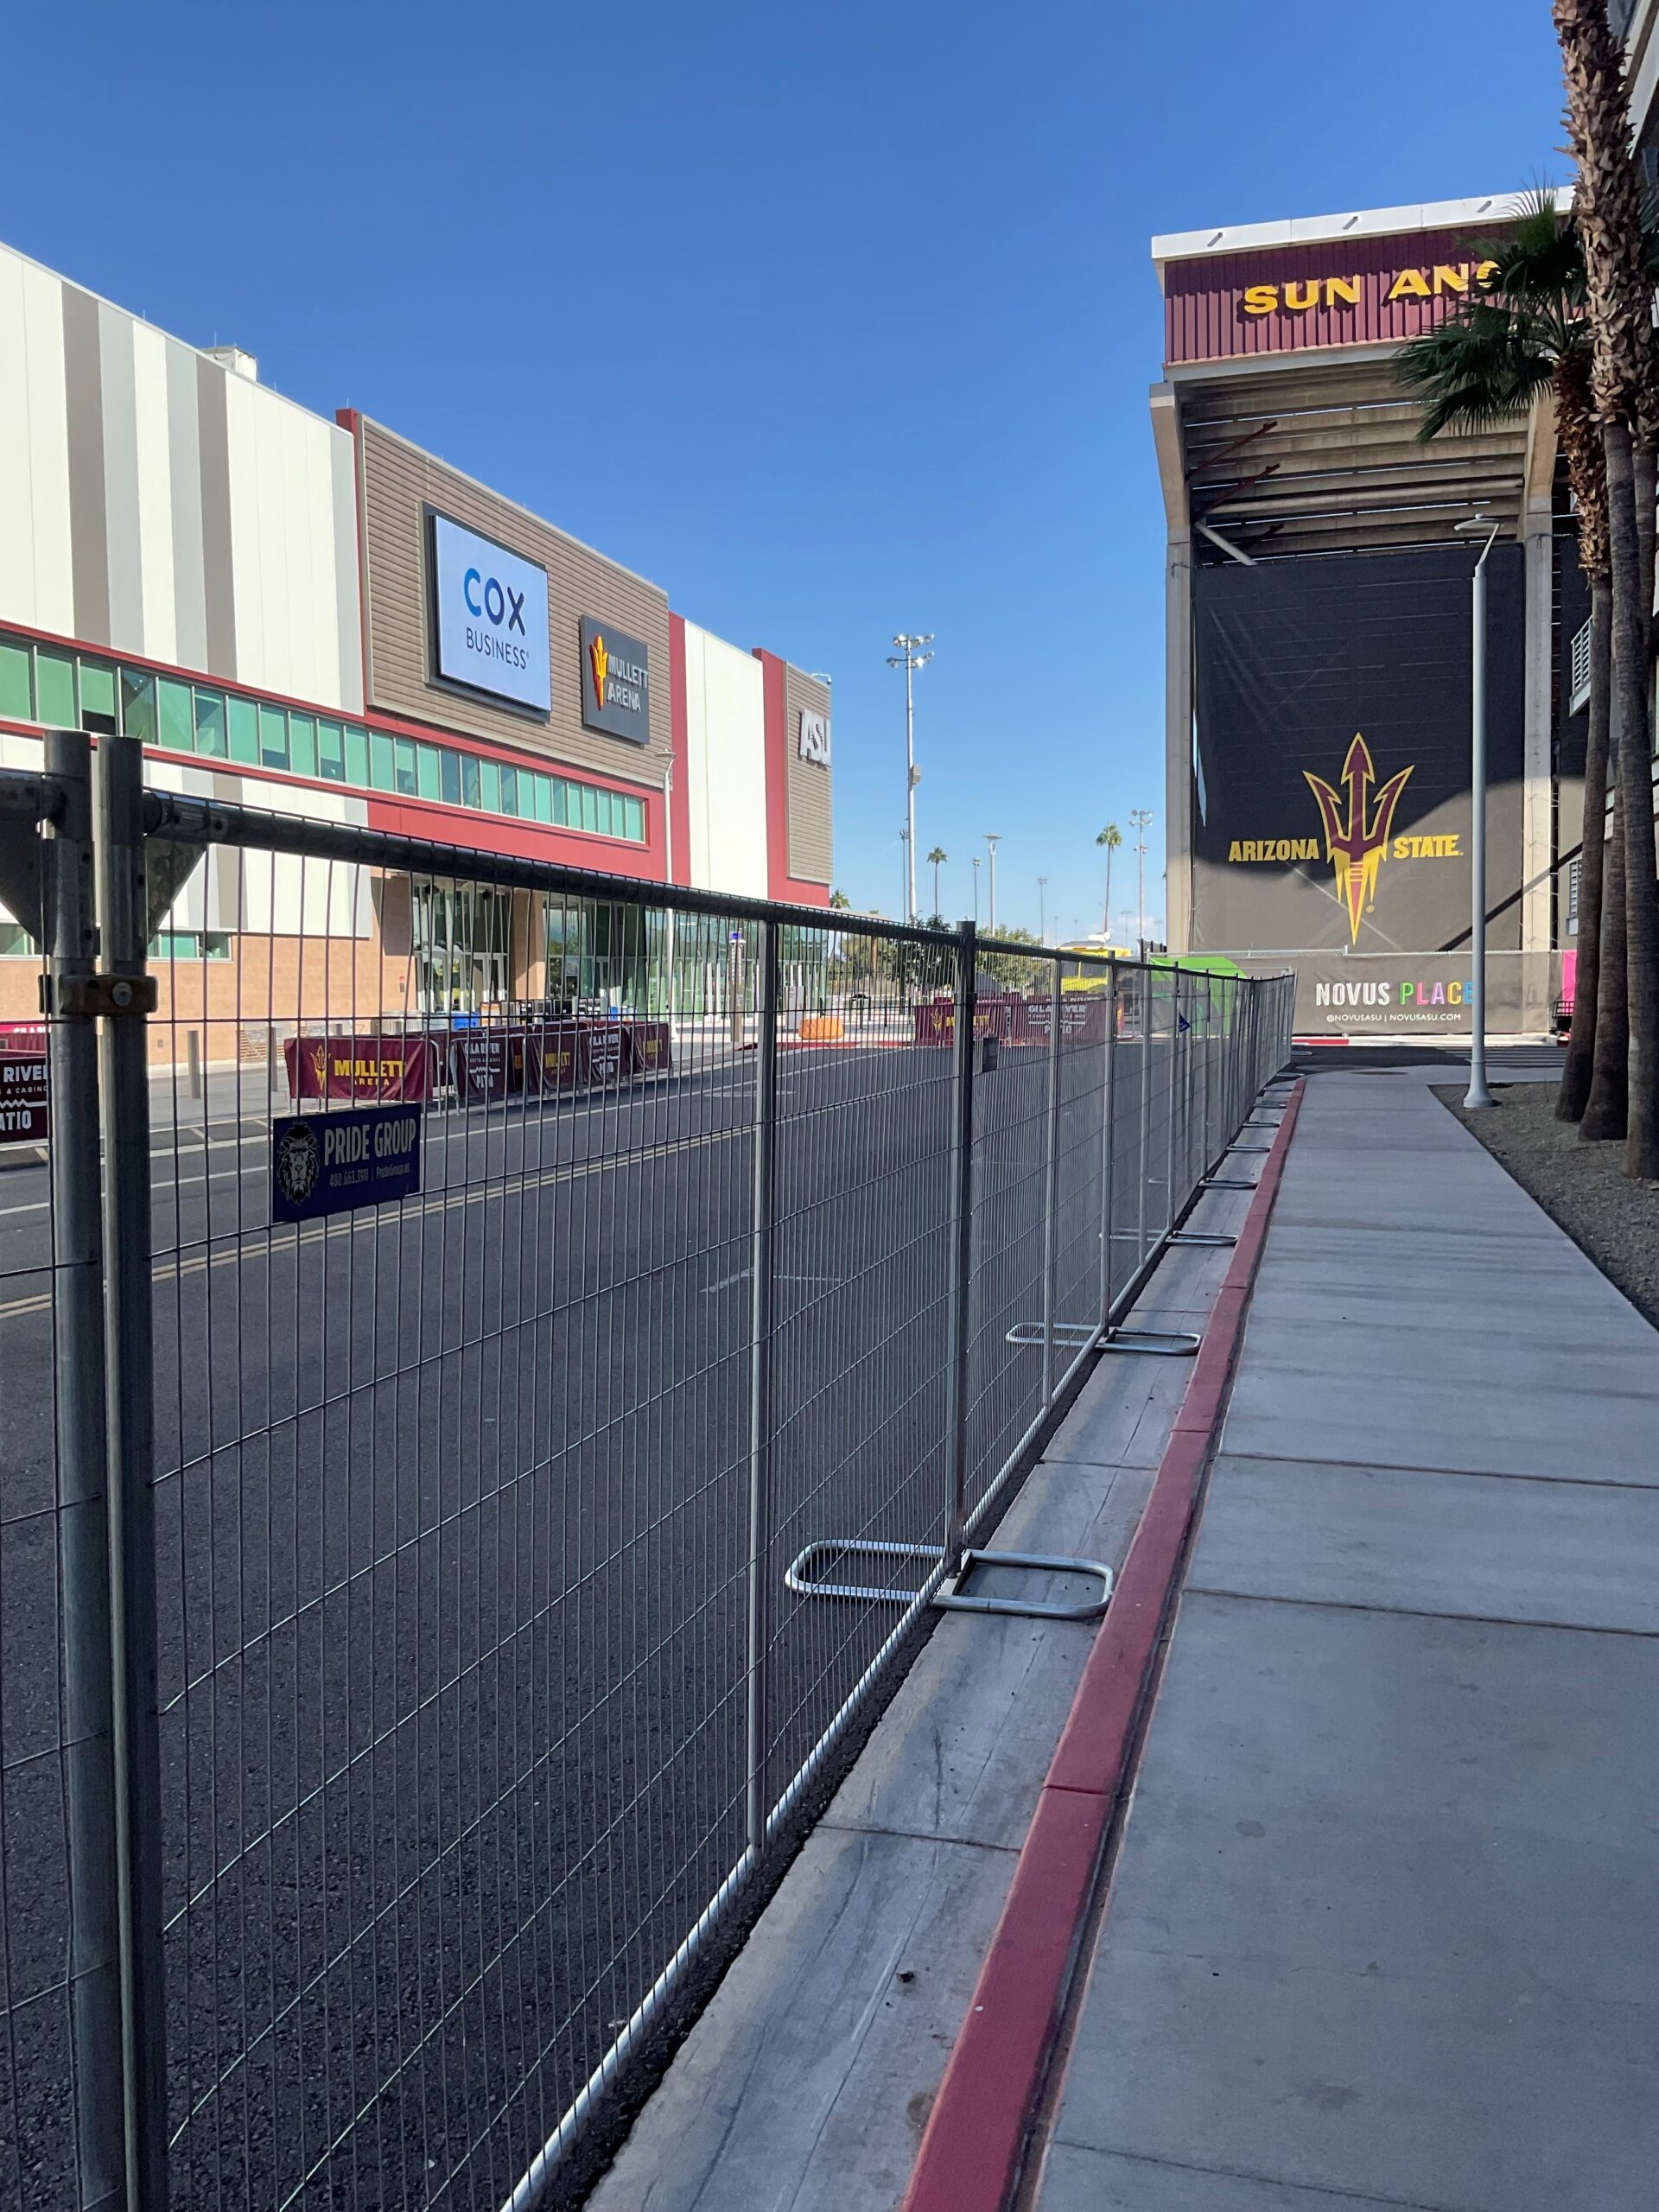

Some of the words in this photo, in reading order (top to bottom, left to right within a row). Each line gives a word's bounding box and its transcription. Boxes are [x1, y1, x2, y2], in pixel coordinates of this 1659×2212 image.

[1243, 275, 1361, 315] SUN
[463, 567, 525, 637] COX
[466, 626, 527, 670] BUSINESS
[607, 653, 648, 689] MULLETT
[607, 682, 641, 712] ARENA
[799, 708, 832, 768] ASU
[1228, 838, 1320, 862] ARIZONA
[1393, 834, 1460, 859] STATE
[1315, 982, 1390, 1007] NOVUS
[1398, 981, 1474, 1006] PLACE
[1325, 1013, 1382, 1023] @NOVUSASU
[1389, 1013, 1462, 1022] NOVUSASU.COM
[334, 1059, 404, 1077] MULLETT
[324, 1124, 371, 1166] PRIDE
[374, 1117, 416, 1159] GROUP
